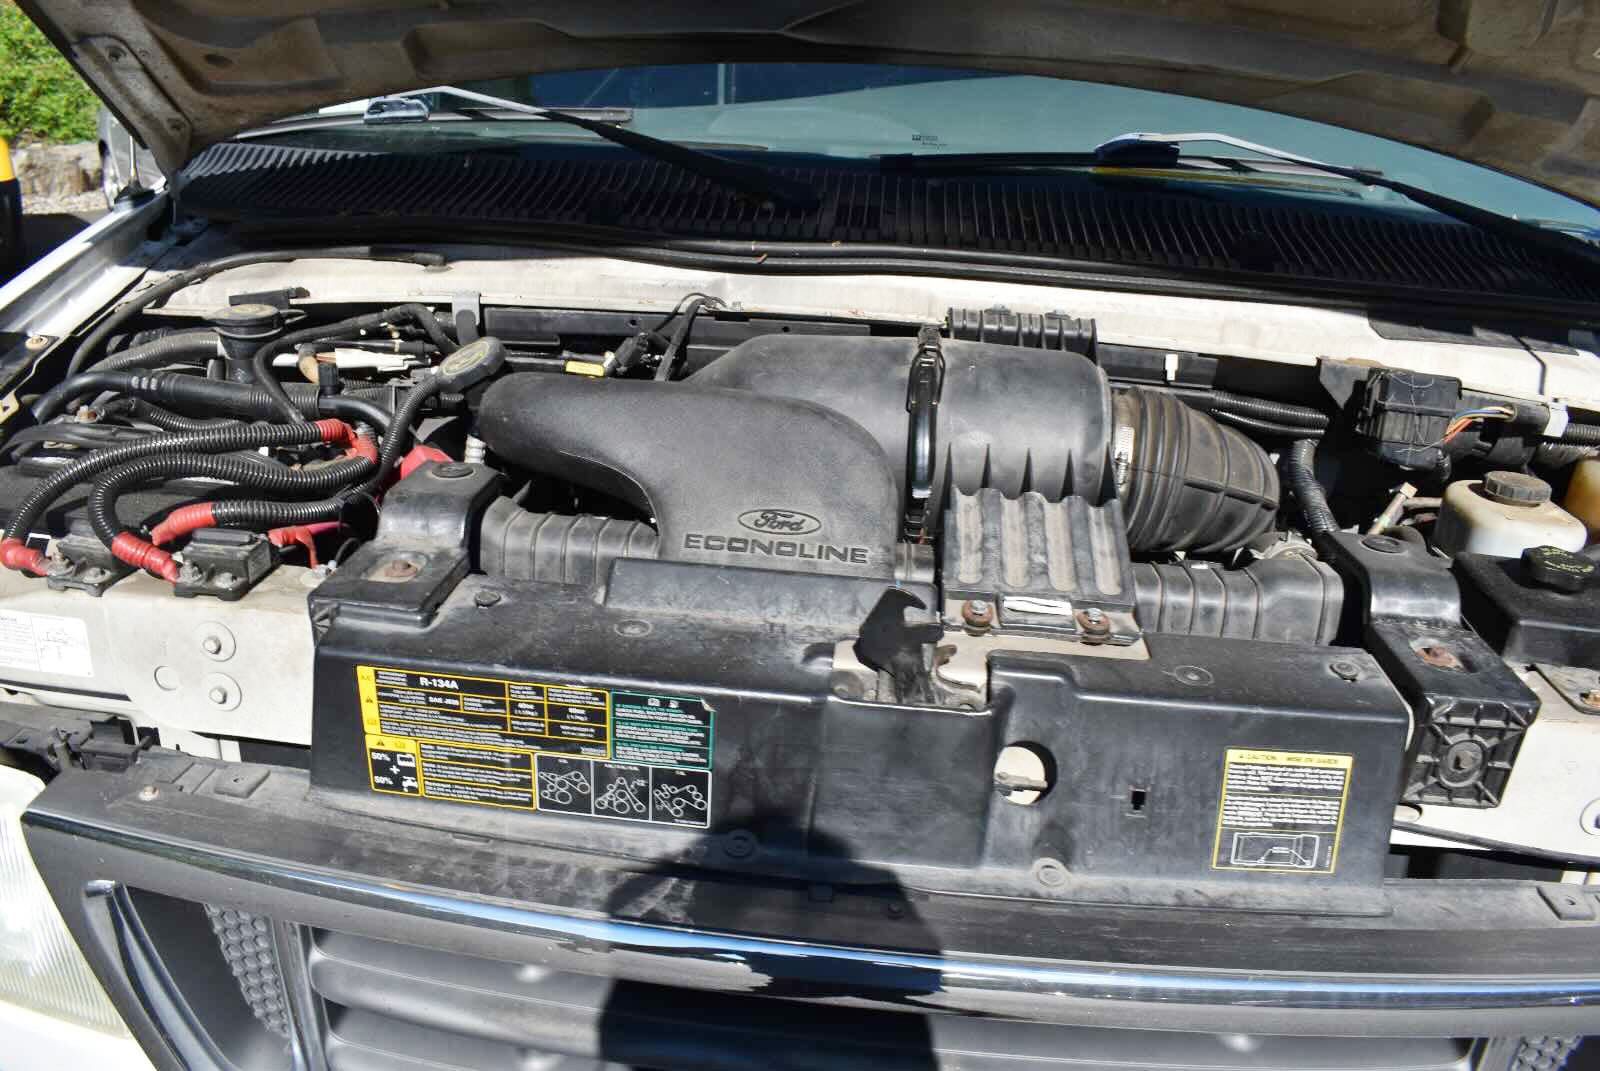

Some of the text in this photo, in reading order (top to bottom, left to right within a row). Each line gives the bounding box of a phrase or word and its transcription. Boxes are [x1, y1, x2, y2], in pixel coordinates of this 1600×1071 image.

[753, 510, 805, 532] Ford
[684, 533, 869, 564] ECONOLINE
[419, 677, 459, 690] R-134A
[371, 751, 391, 761] 50%
